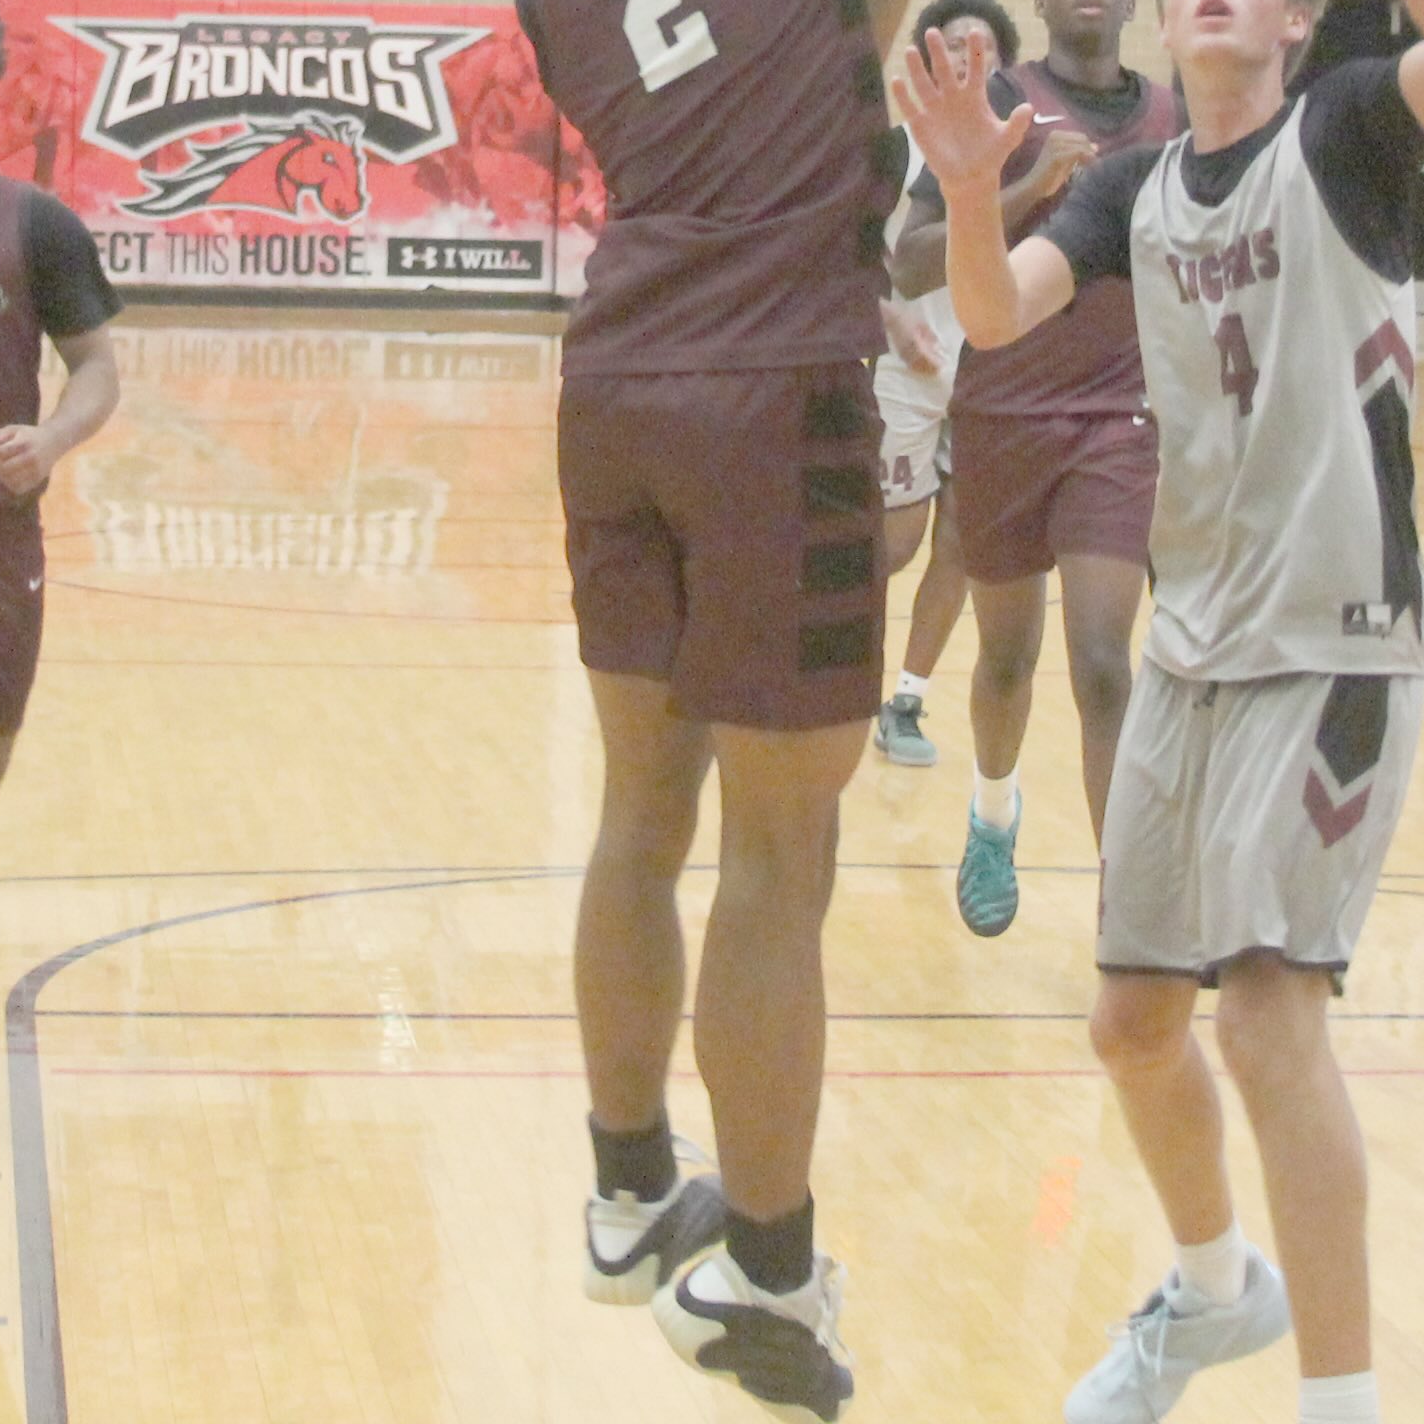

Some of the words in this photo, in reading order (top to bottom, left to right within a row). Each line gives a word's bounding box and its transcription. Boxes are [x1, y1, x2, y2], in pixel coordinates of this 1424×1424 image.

[195, 27, 353, 46] LEGACY
[104, 30, 436, 131] BRONCOS
[165, 232, 228, 275] THIS
[444, 247, 457, 269] I
[1214, 313, 1259, 417] 4
